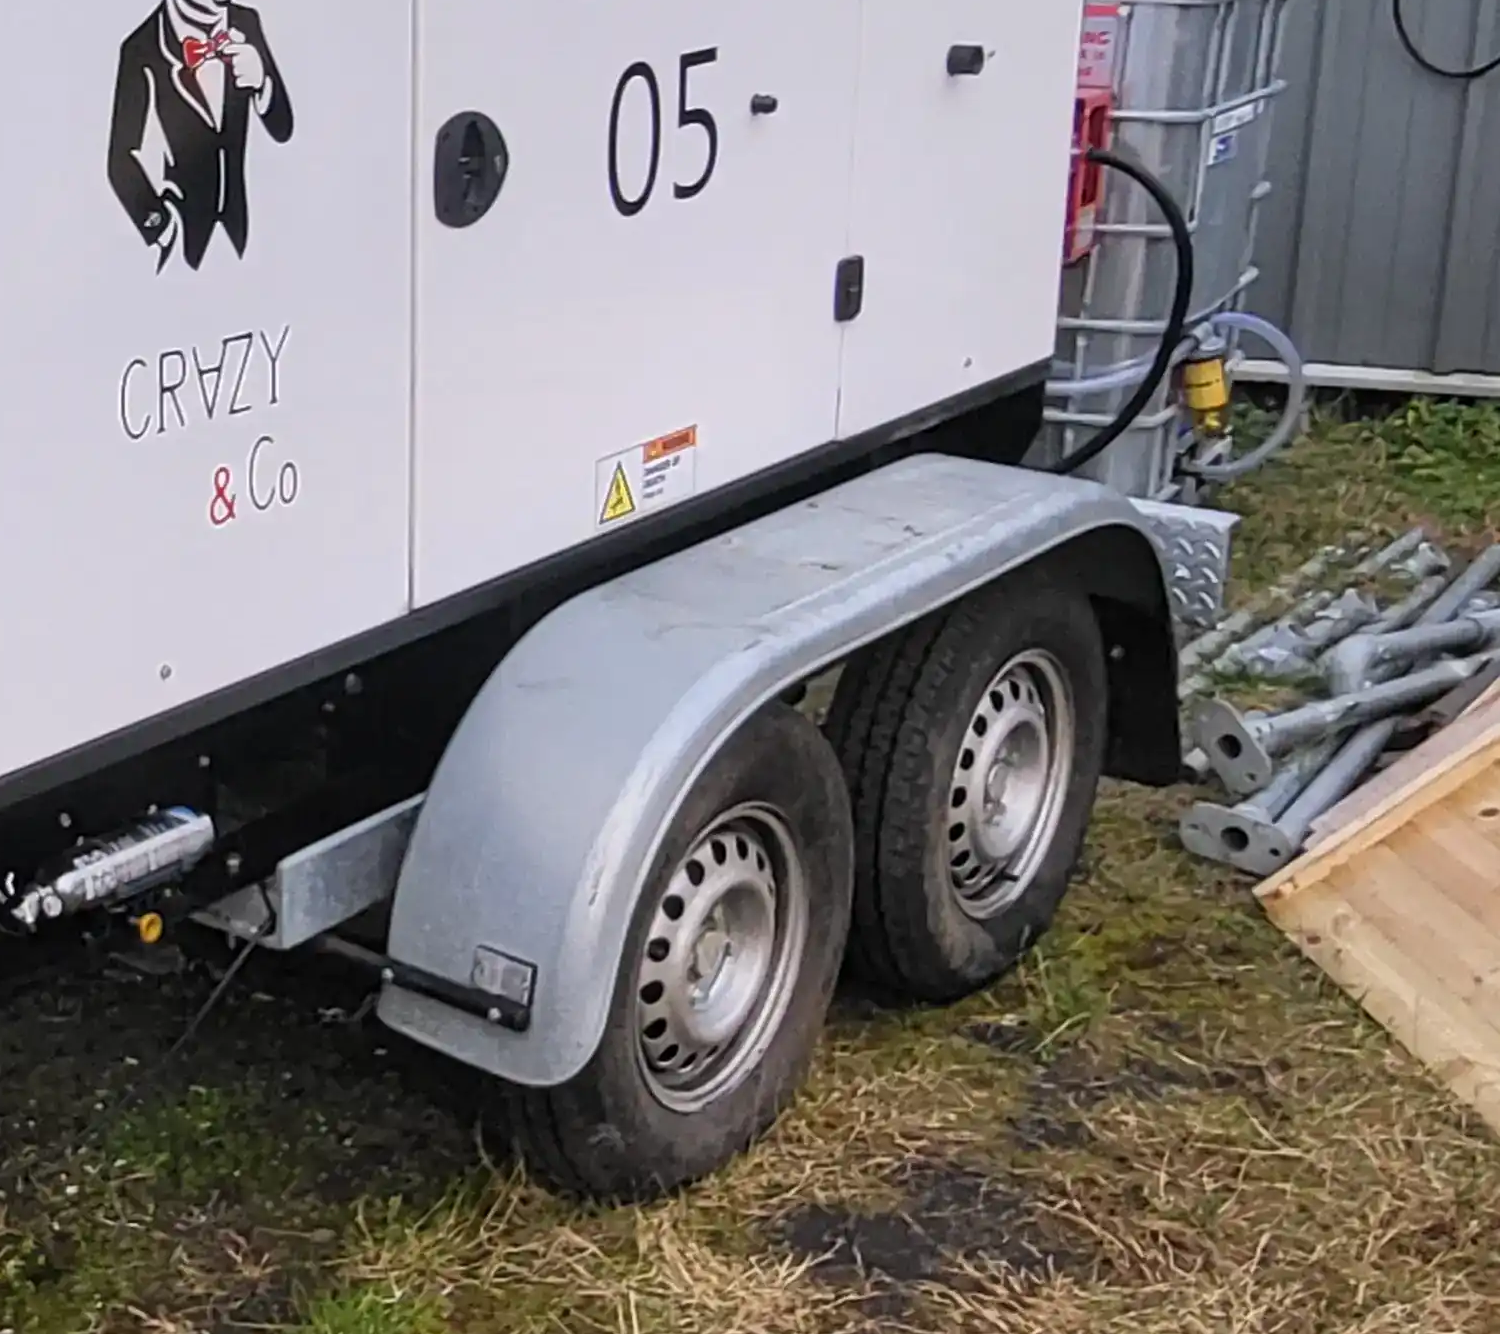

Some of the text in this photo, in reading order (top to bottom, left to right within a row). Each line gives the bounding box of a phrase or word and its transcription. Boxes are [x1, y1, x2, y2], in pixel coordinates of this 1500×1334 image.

[608, 47, 718, 217] 05
[121, 325, 289, 440] CRAZY
[210, 436, 297, 525] & Co
